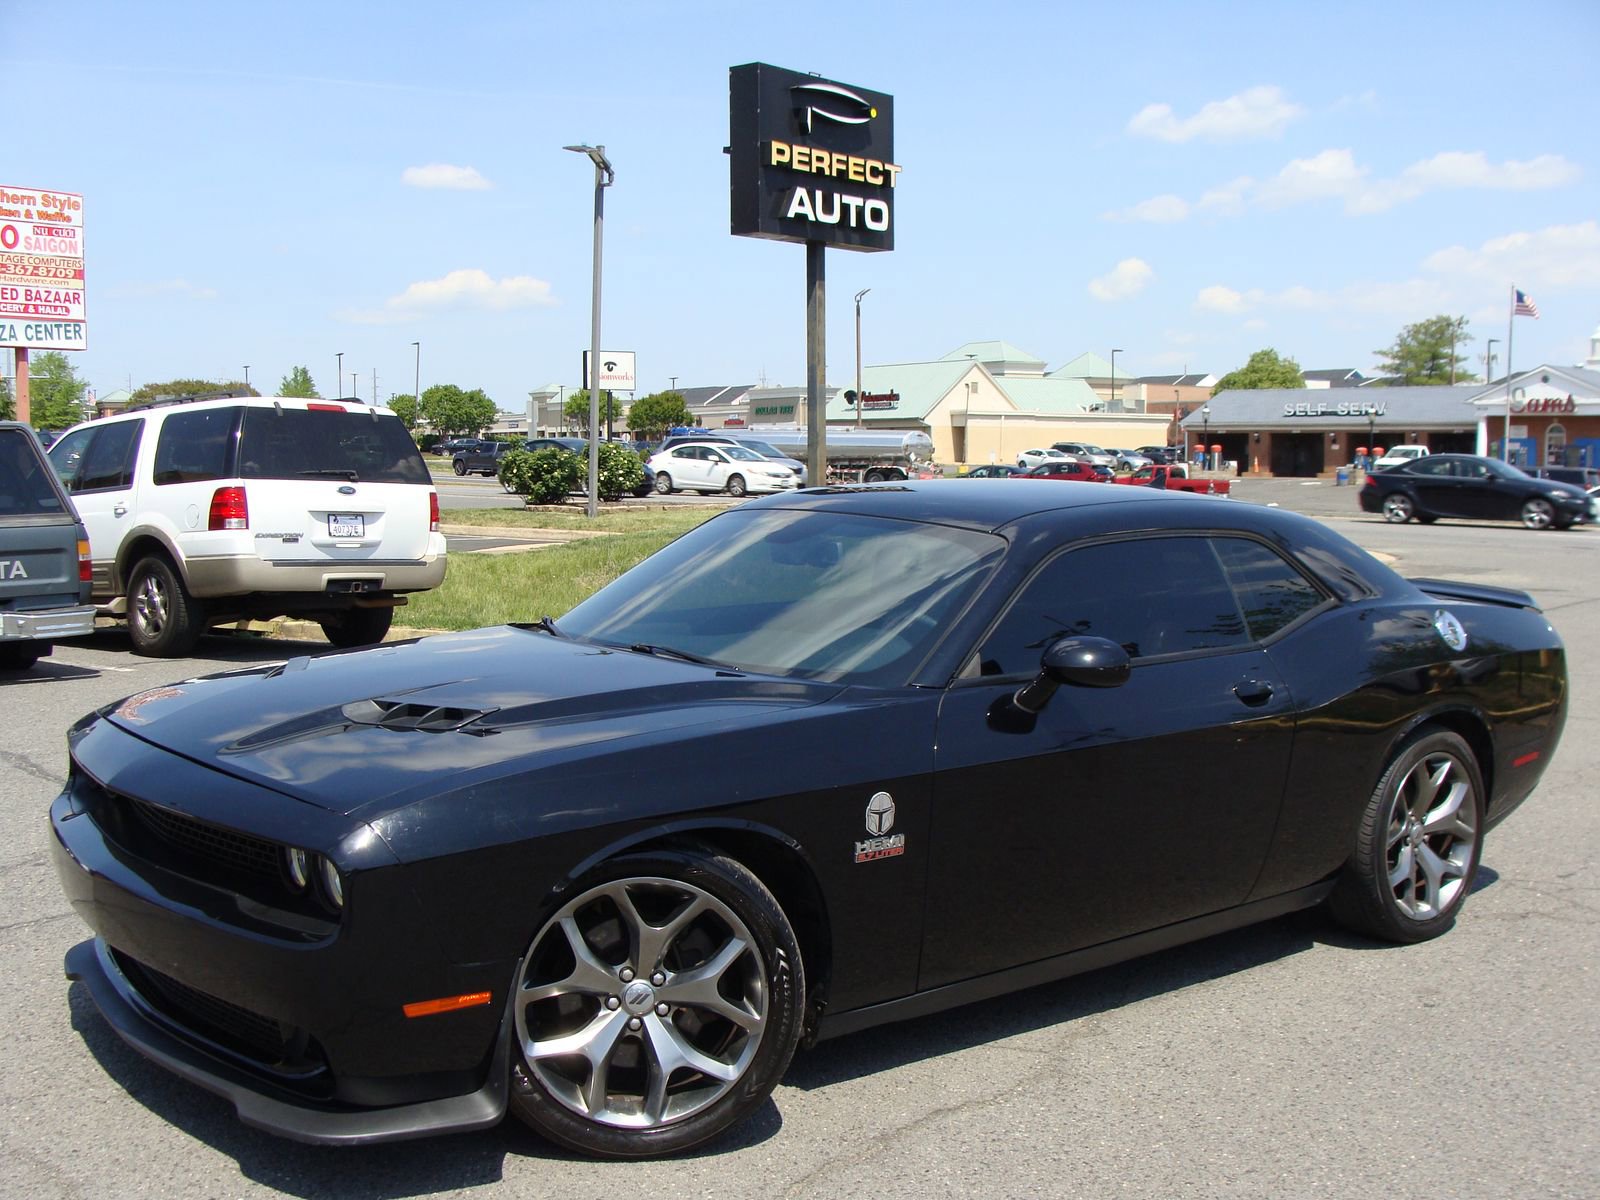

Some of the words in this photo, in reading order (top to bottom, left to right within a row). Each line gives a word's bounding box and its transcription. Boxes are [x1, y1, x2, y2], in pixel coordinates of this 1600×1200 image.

[771, 140, 902, 188] PERFECT
[41, 194, 80, 211] Style
[787, 186, 889, 232] AUTO
[24, 209, 33, 219] &
[24, 236, 78, 254] SAIGON
[27, 257, 82, 268] COMPUTERS
[1, 288, 19, 300] ED
[25, 289, 81, 304] BAZAAR
[0, 303, 26, 312] CERY
[38, 305, 67, 315] HALAL
[25, 324, 82, 341] CENTER
[1283, 402, 1328, 416] SELF
[1337, 401, 1386, 415] SERV
[0, 560, 28, 579] TA
